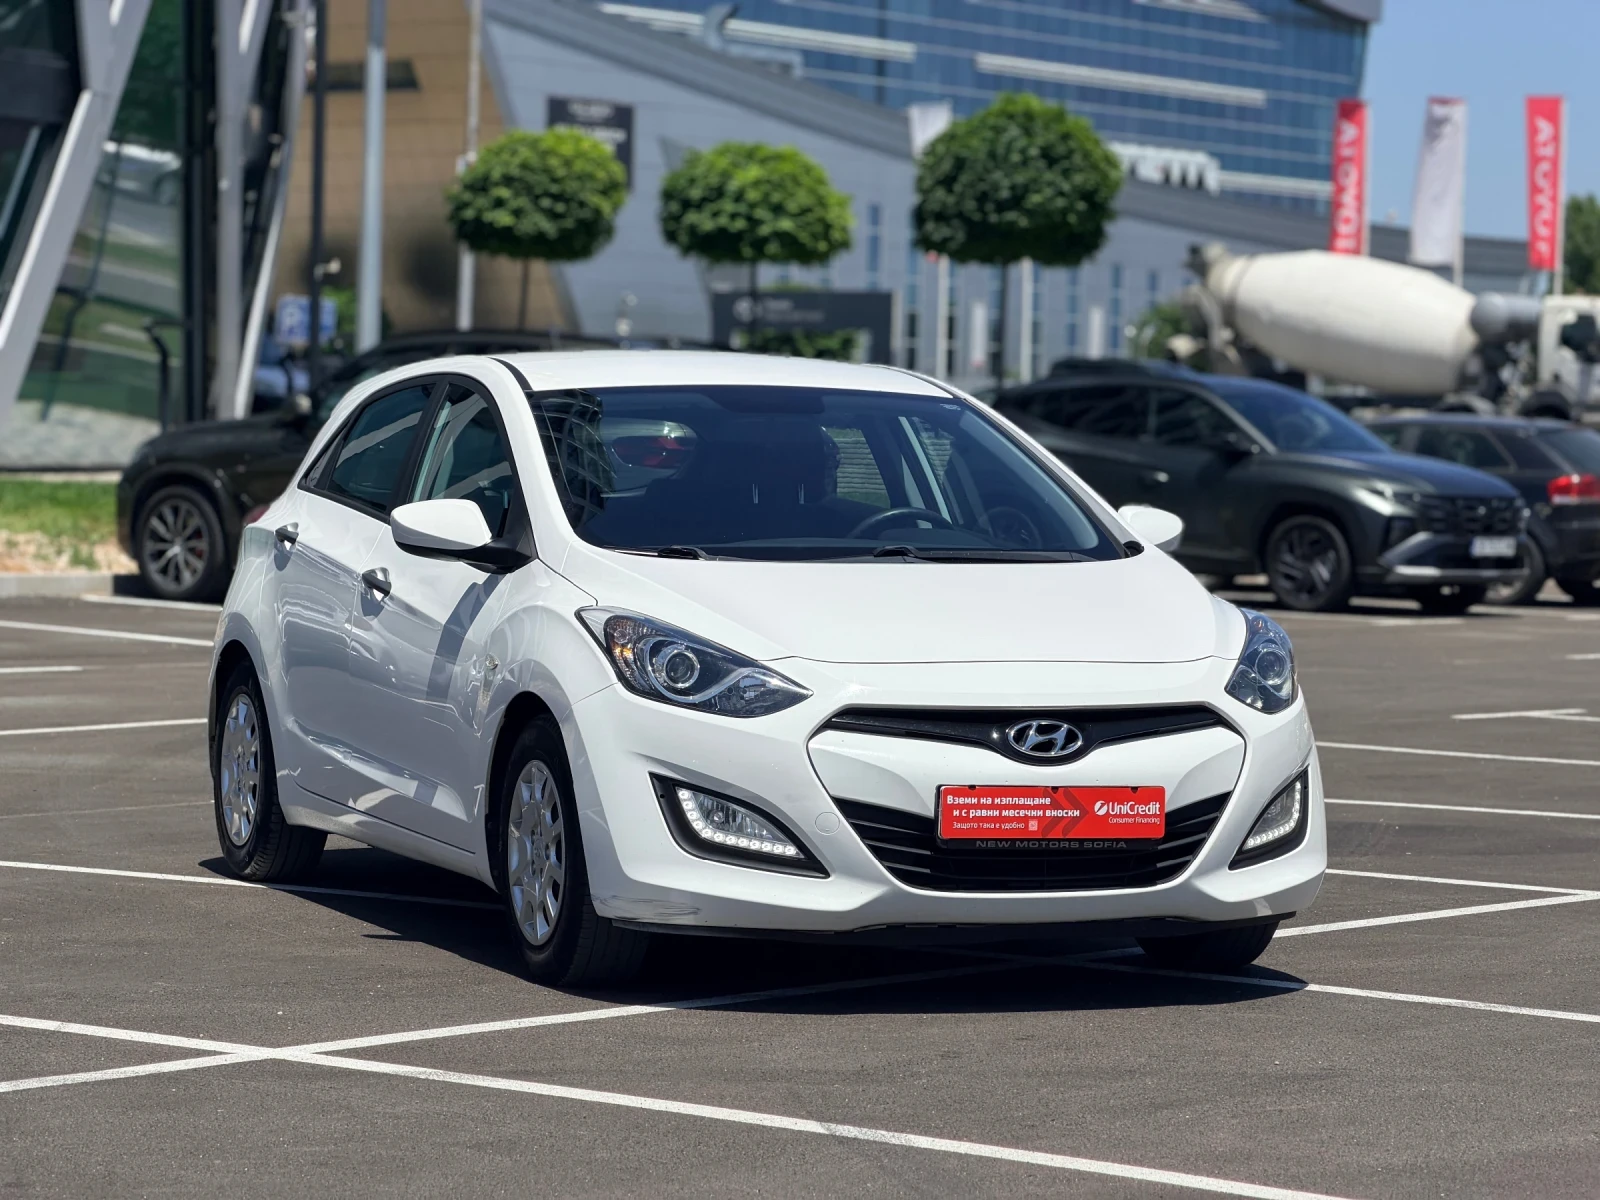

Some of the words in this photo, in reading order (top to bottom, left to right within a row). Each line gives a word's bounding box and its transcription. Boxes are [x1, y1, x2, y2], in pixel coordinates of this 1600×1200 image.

[946, 795, 978, 805] Вземи
[980, 797, 992, 805] на
[994, 797, 1051, 806] изплащане
[1108, 801, 1161, 815] UniCredit
[953, 809, 959, 817] и
[961, 809, 967, 817] с
[969, 809, 1000, 818] равни
[1001, 809, 1043, 817] месечни
[1045, 809, 1080, 817] вноски
[1001, 821, 1025, 830] удобно
[1136, 817, 1161, 825] Financing
[975, 840, 1012, 848] NEW
[1015, 840, 1079, 848] MOTORS
